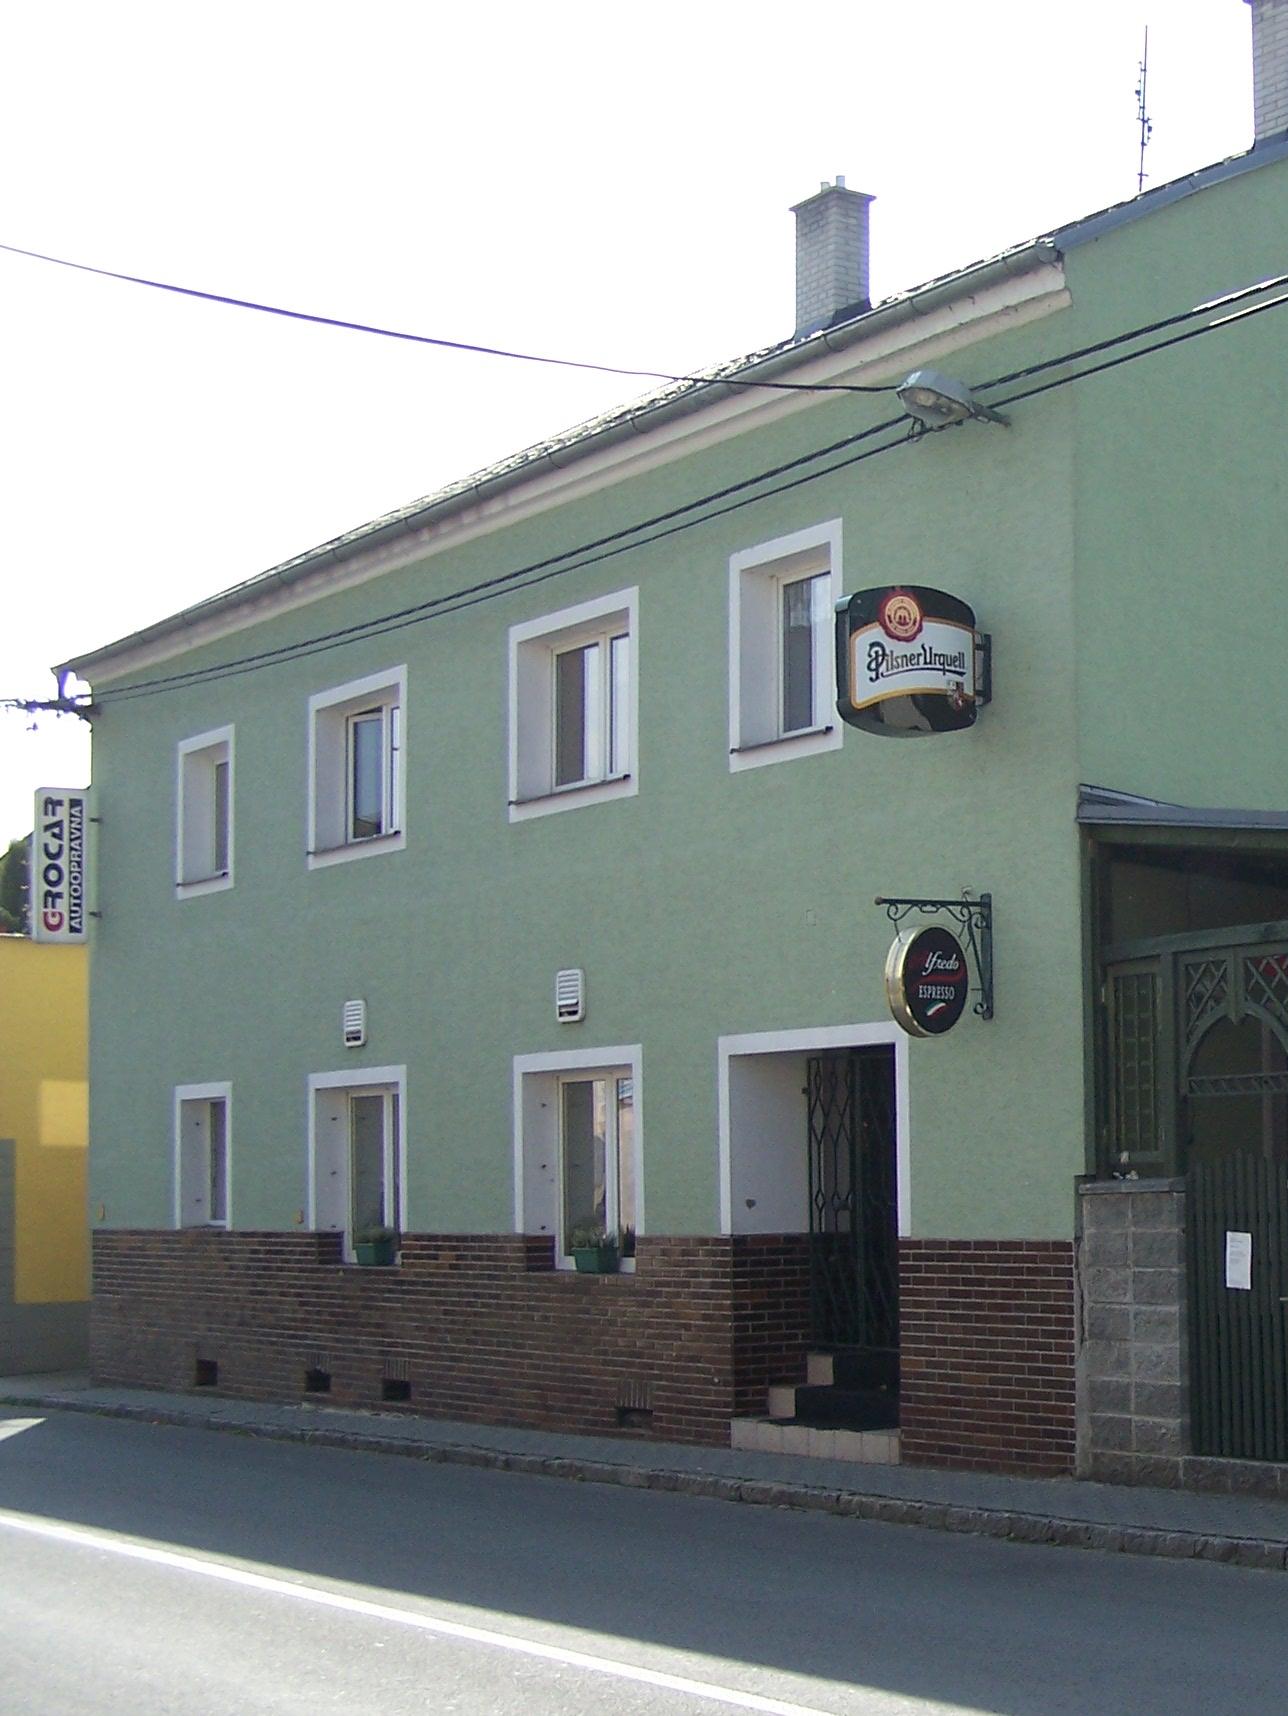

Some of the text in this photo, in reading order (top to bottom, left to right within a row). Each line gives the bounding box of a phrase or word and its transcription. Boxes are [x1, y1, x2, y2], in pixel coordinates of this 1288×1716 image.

[867, 641, 965, 683] Pilsner Urquell
[43, 796, 64, 932] GROCAR
[70, 806, 82, 929] AUTOOPRAVNA
[918, 984, 955, 1000] ESPRESSO
